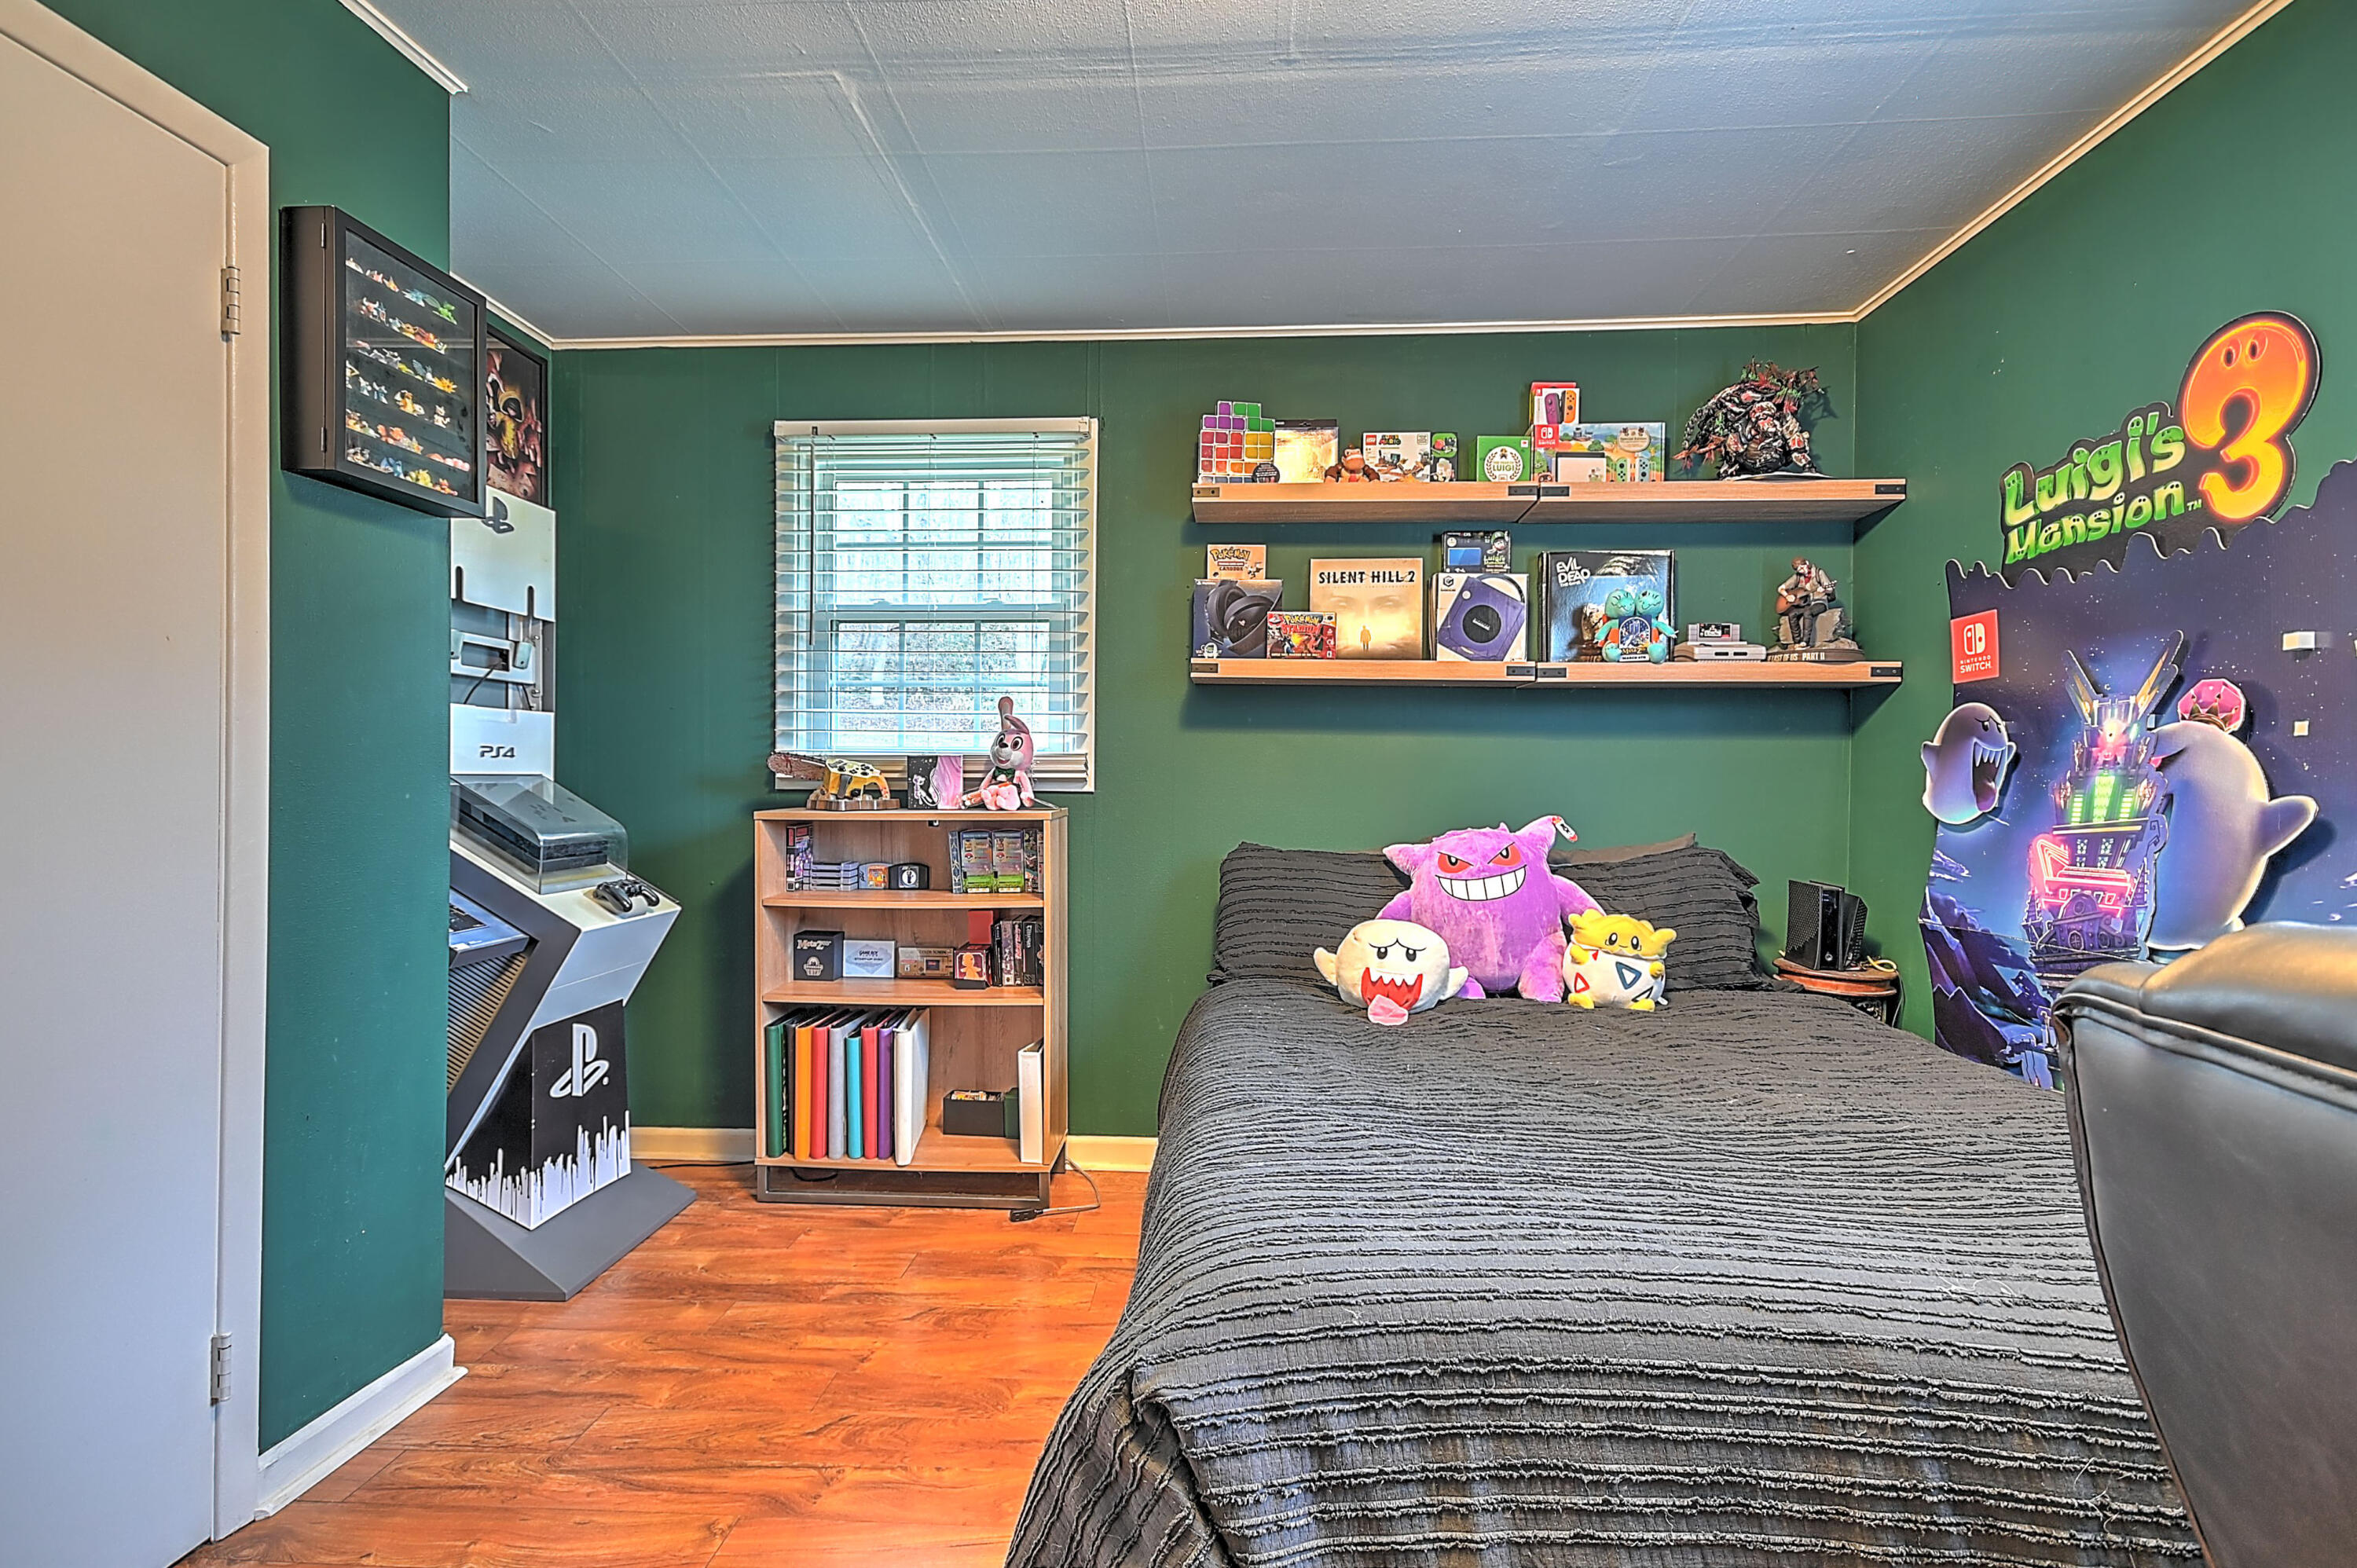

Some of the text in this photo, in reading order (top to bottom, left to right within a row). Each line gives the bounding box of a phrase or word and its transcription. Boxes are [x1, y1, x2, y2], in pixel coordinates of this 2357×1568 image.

[2183, 321, 2308, 522] 3
[2003, 411, 2187, 527] Luigi's
[2004, 481, 2185, 565] Mansion
[1556, 556, 1582, 573] EVIL
[1319, 570, 1415, 584] SILENT HILL 2
[1558, 568, 1591, 584] DEAD
[1802, 652, 1819, 661] PART
[1960, 661, 1992, 673] SWITCH
[479, 746, 515, 758] PS4
